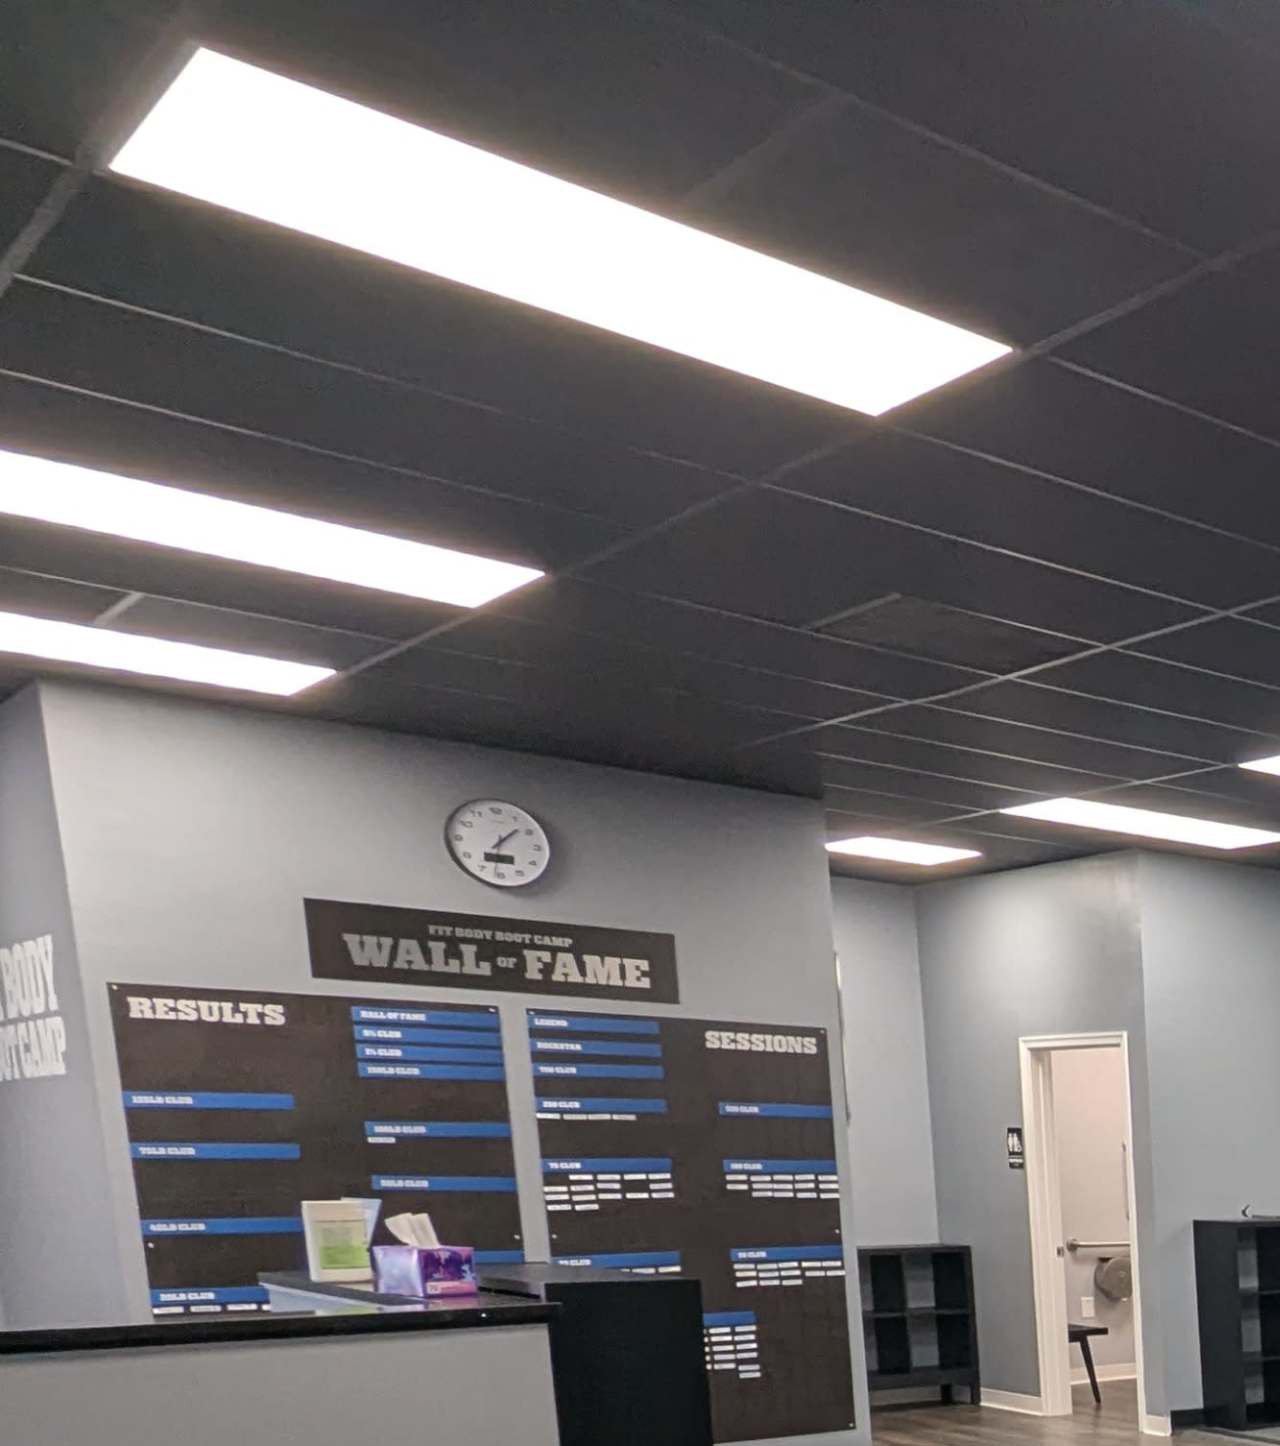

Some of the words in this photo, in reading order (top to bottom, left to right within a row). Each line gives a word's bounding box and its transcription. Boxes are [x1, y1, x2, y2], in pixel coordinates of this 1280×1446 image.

[428, 924, 452, 937] FIT
[455, 926, 495, 941] BODY
[496, 930, 532, 944] BOOT
[533, 933, 573, 948] CAMP
[341, 933, 492, 976] WALL
[496, 956, 517, 969] OF
[523, 949, 651, 989] FAME
[0, 934, 58, 1019] BODY
[127, 996, 286, 1025] RESULTS
[400, 1013, 426, 1021] FAME
[377, 1030, 402, 1039] CLUB
[17, 1016, 66, 1078] CAMP
[705, 1030, 817, 1055] SESSIONS
[378, 1048, 402, 1057] CLUB
[165, 1096, 193, 1105] CLUB
[167, 1147, 196, 1155] CLUB
[178, 1223, 206, 1231] CLUB
[187, 1292, 215, 1300] CLUB
